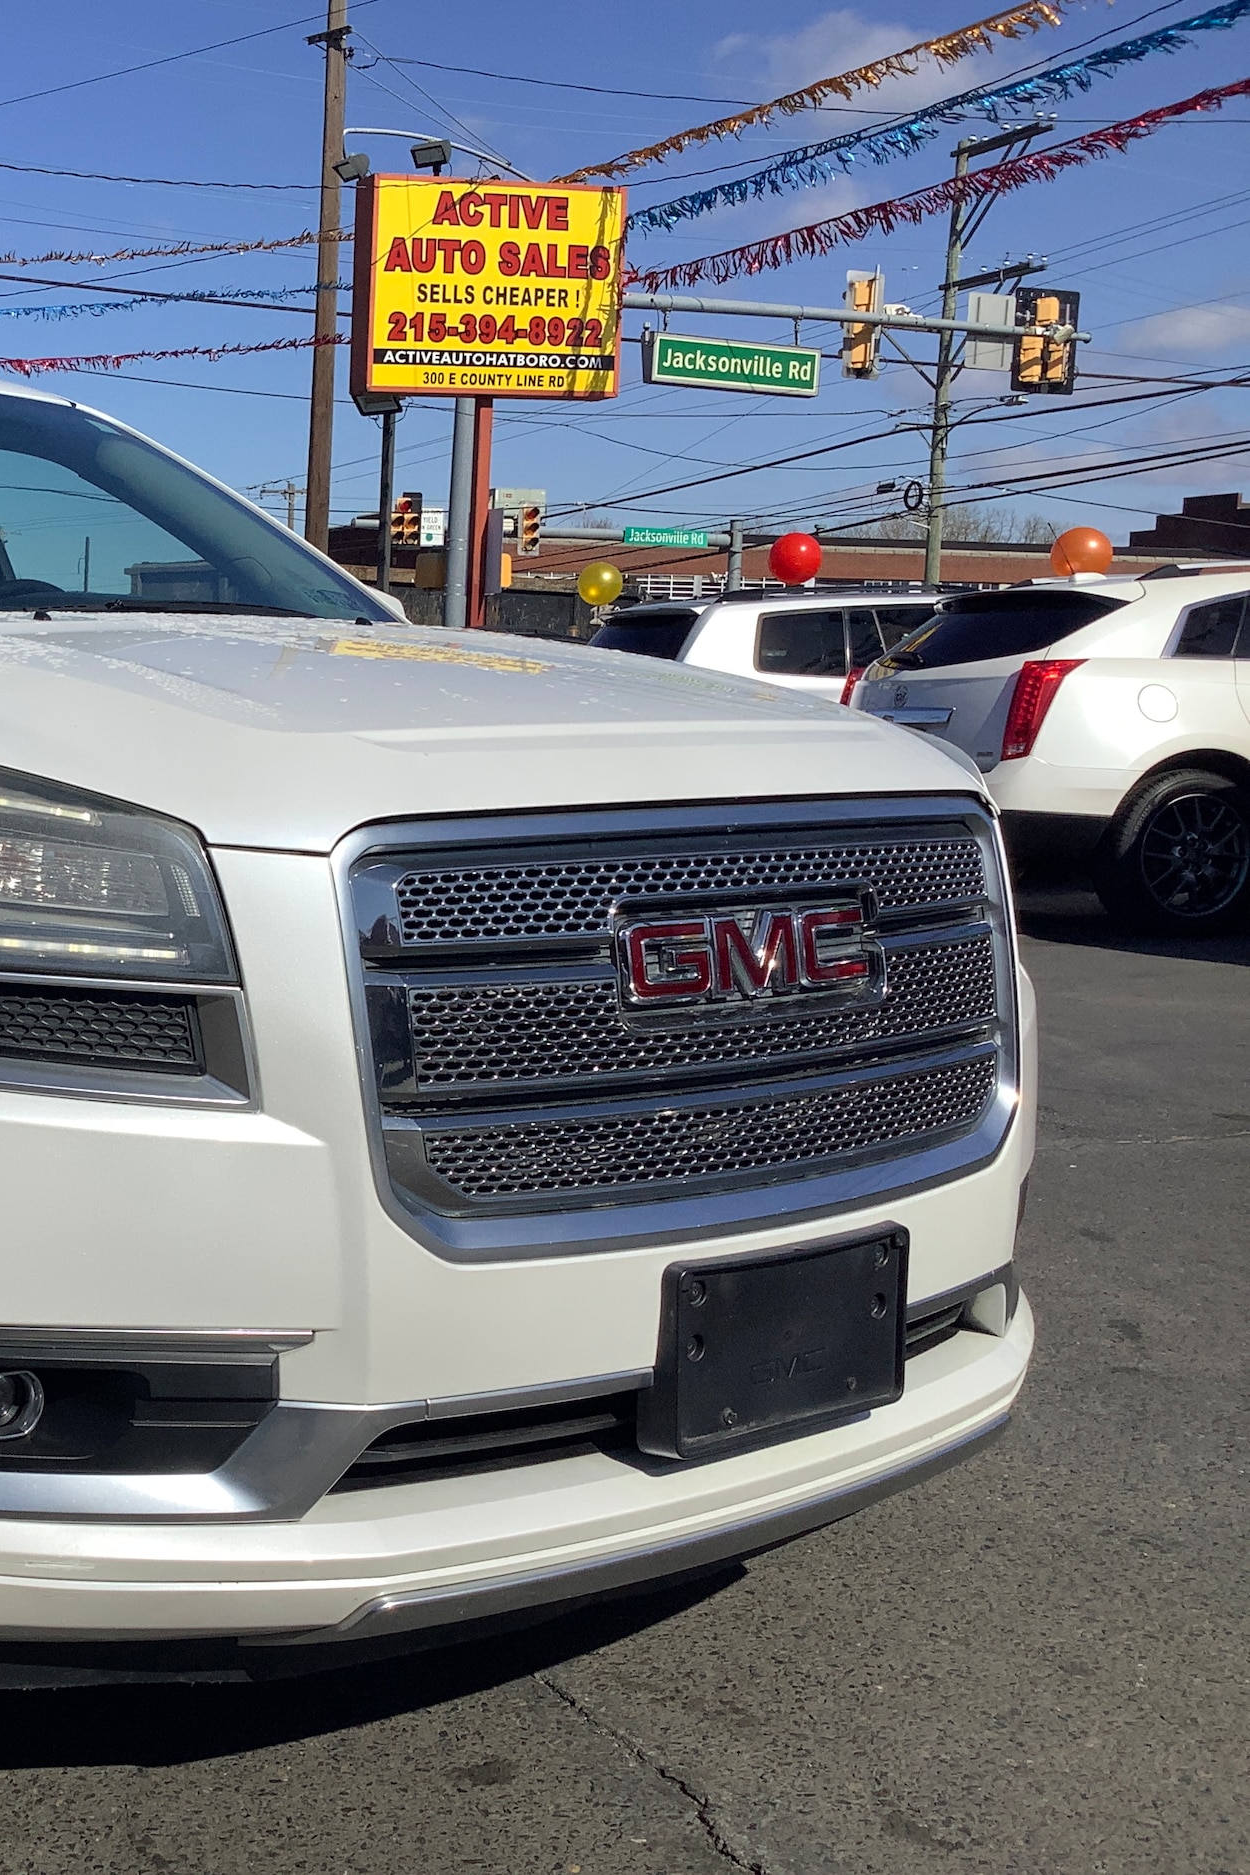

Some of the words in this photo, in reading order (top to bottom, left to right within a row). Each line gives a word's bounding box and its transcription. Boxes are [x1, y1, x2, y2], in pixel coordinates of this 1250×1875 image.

[432, 191, 569, 231] ACTIVE
[384, 237, 486, 275] AUTO
[498, 242, 611, 280] SALES
[417, 283, 475, 305] SELLS
[482, 286, 569, 308] CHEAPER
[387, 311, 603, 348] 215-394-8922
[383, 350, 602, 369] ACTIVEAUTOHATBORO.COM
[662, 348, 783, 378] Jacksonville
[788, 360, 812, 381] Rd
[423, 372, 444, 384] 300
[449, 373, 456, 384] E
[461, 373, 512, 386] COUNTY
[516, 374, 544, 387] LINE
[549, 376, 565, 387] RD
[423, 516, 439, 524] YIELD
[629, 528, 689, 544] Jacksonville
[691, 533, 704, 545] Rd
[624, 905, 870, 1003] GMC
